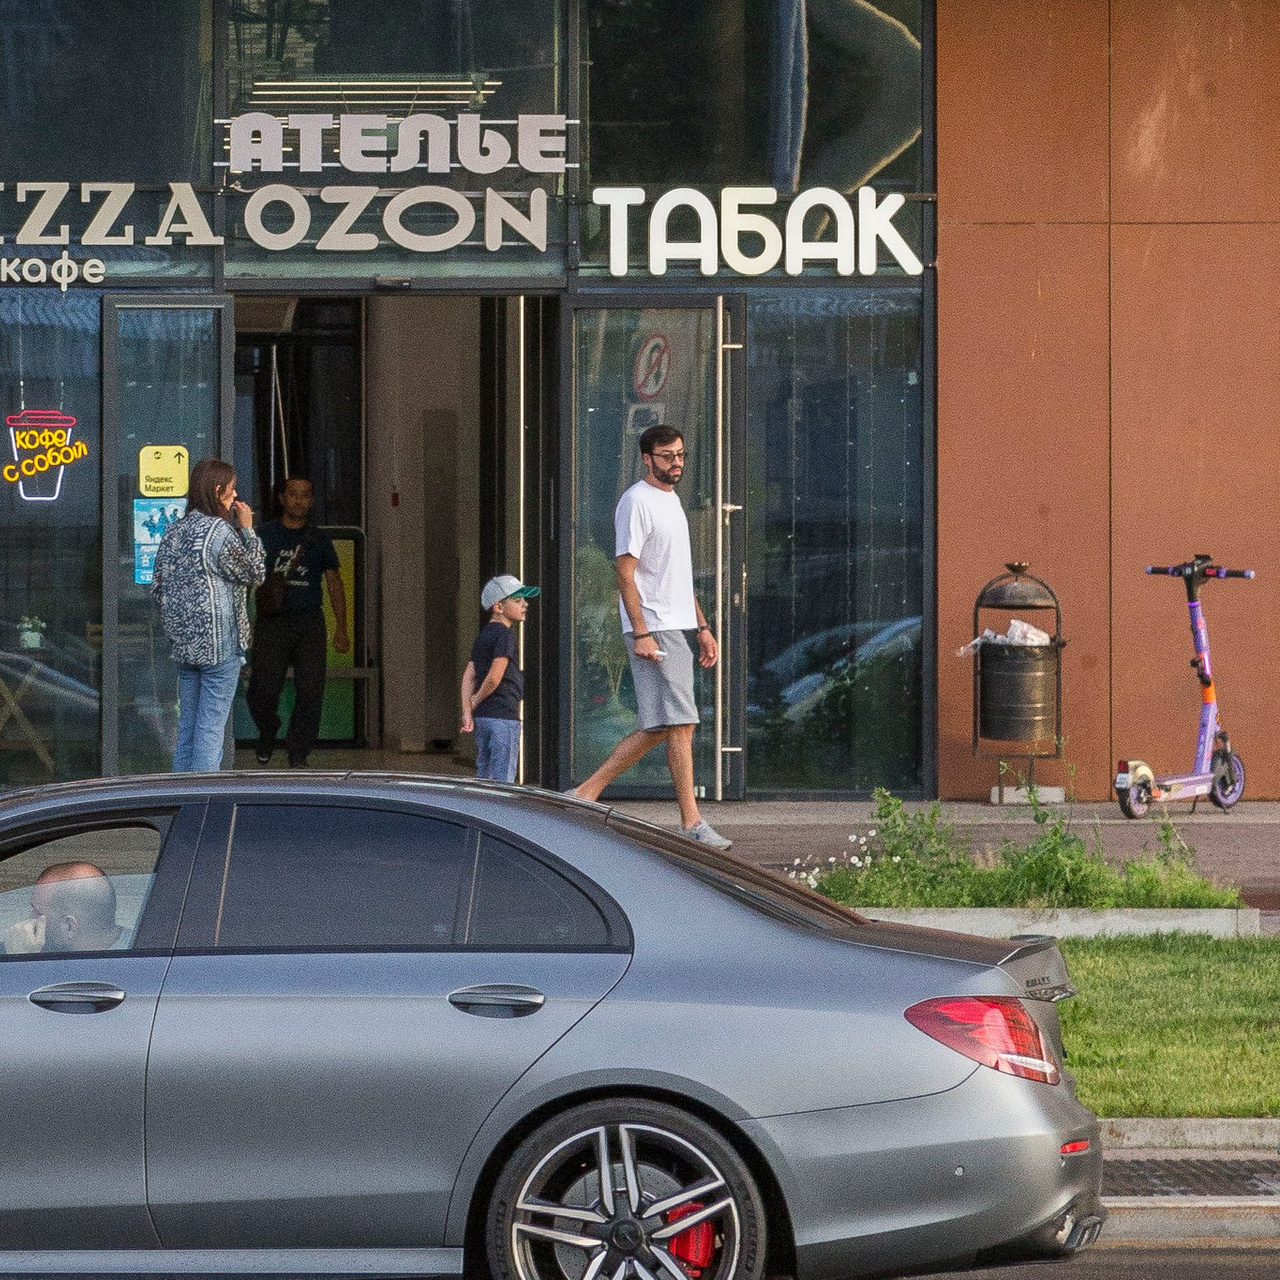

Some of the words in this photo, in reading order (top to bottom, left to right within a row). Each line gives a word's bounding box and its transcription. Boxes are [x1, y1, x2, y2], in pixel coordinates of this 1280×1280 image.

[229, 111, 567, 174] АТЕЛЬЕ
[243, 183, 547, 253] OZON
[592, 186, 924, 277] ТАБАК
[0, 250, 107, 292] кафе
[144, 475, 173, 484] Яндекс
[144, 484, 174, 493] Маркет
